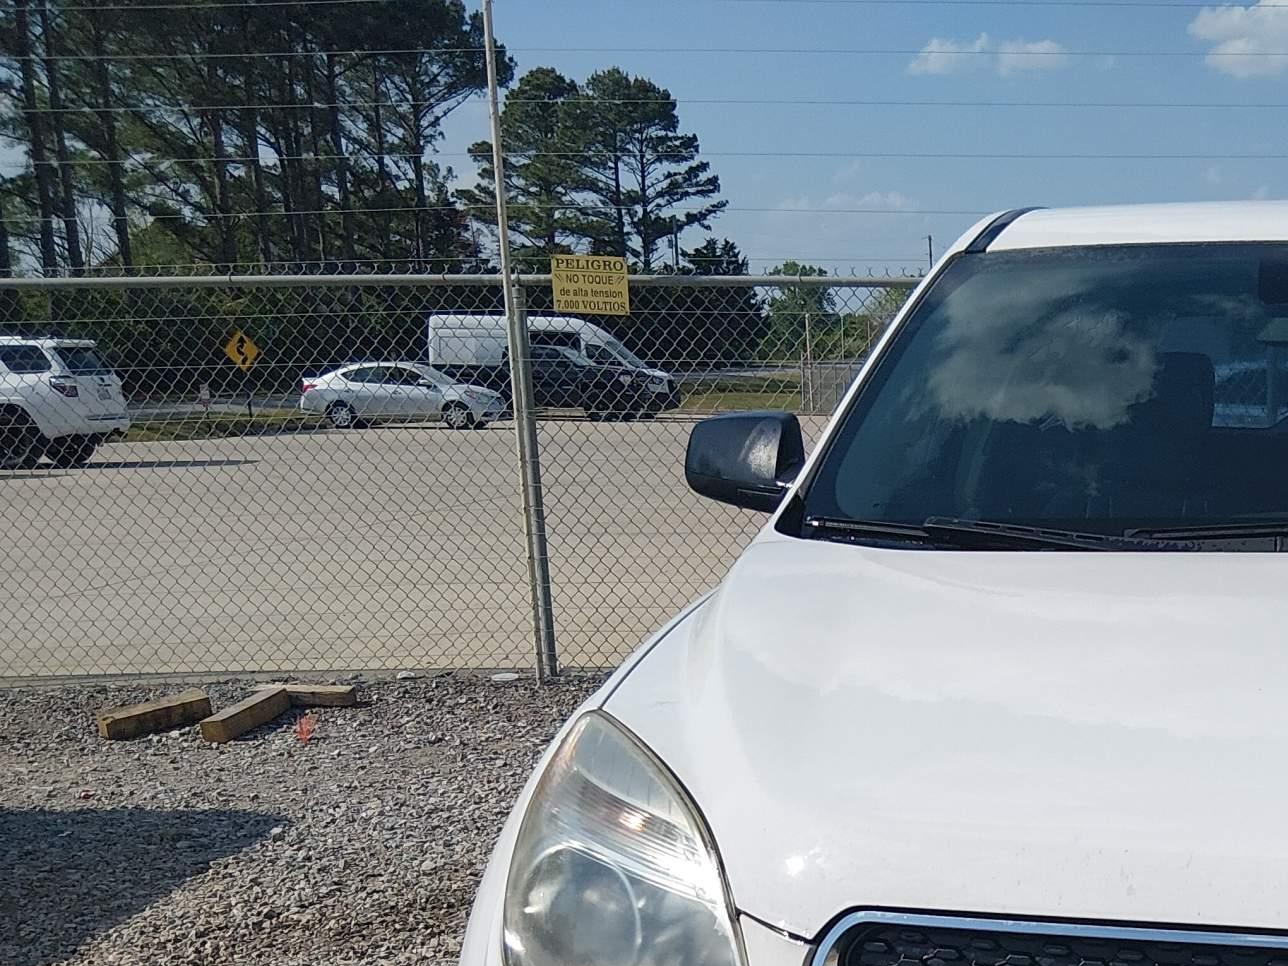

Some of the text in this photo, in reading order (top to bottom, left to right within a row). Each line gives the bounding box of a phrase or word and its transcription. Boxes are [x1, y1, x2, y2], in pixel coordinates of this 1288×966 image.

[555, 258, 624, 271] PELIGRO
[566, 274, 614, 285] NO TOQUE
[560, 288, 623, 299] de alta tension
[582, 301, 626, 312] VOLTIOS
